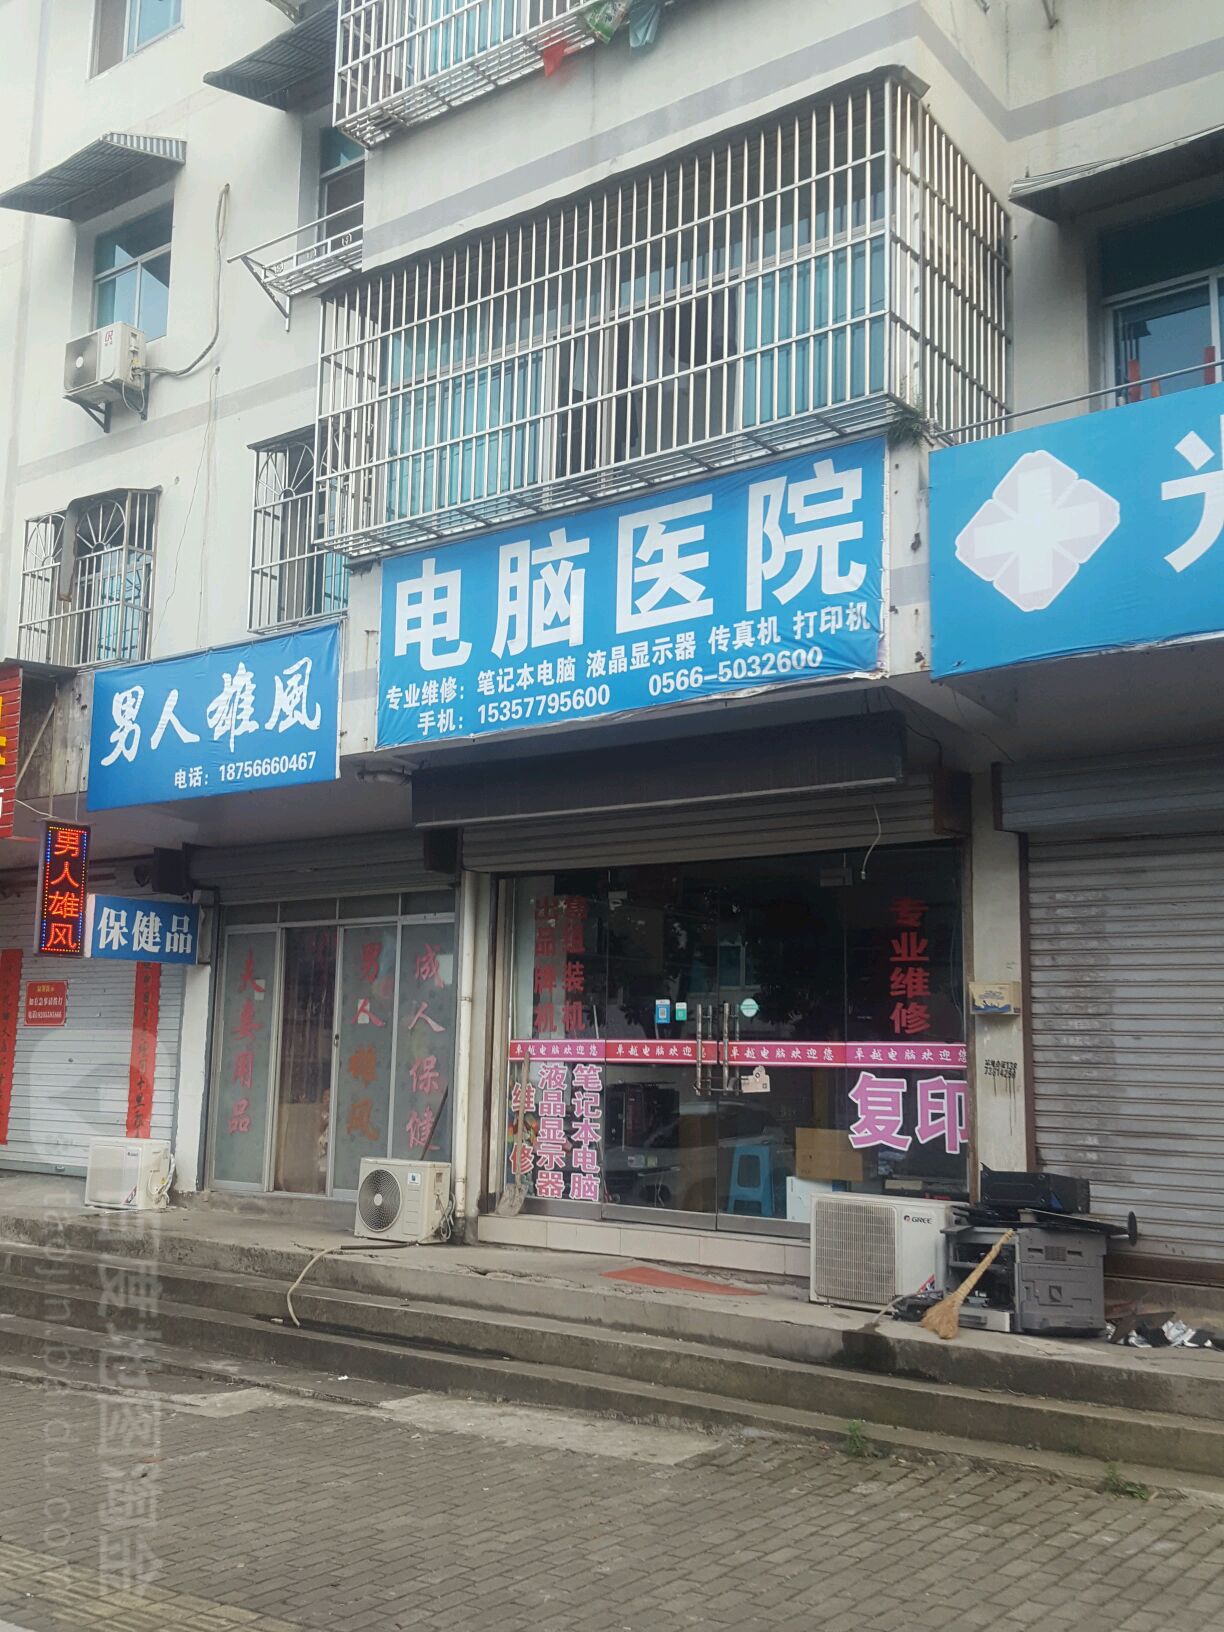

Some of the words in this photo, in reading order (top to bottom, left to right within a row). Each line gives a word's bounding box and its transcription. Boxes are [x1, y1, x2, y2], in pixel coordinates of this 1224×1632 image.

[394, 458, 867, 671] 电脑医院
[386, 681, 465, 711] 专业维修：
[477, 656, 576, 695] 笔记本电脑
[586, 632, 696, 678] 液晶显示器
[708, 617, 781, 655] 传真机
[793, 601, 871, 641] 打印机
[417, 710, 464, 736] 手机：
[477, 684, 611, 725] 15357795600
[648, 646, 824, 697] 0566-5032600
[174, 767, 209, 789] 电话：
[219, 751, 317, 783] 18756660467
[47, 830, 80, 949] 男人雄风
[98, 907, 193, 954] 保健品
[889, 896, 931, 1034] 专业维修
[406, 943, 445, 1151] 成人保健
[510, 1083, 536, 1175] 维修
[536, 1063, 567, 1199] 液晶显示器
[571, 1063, 603, 1202] 笔记本电脑
[848, 1071, 969, 1155] 复印
[911, 1216, 932, 1224] GREE
